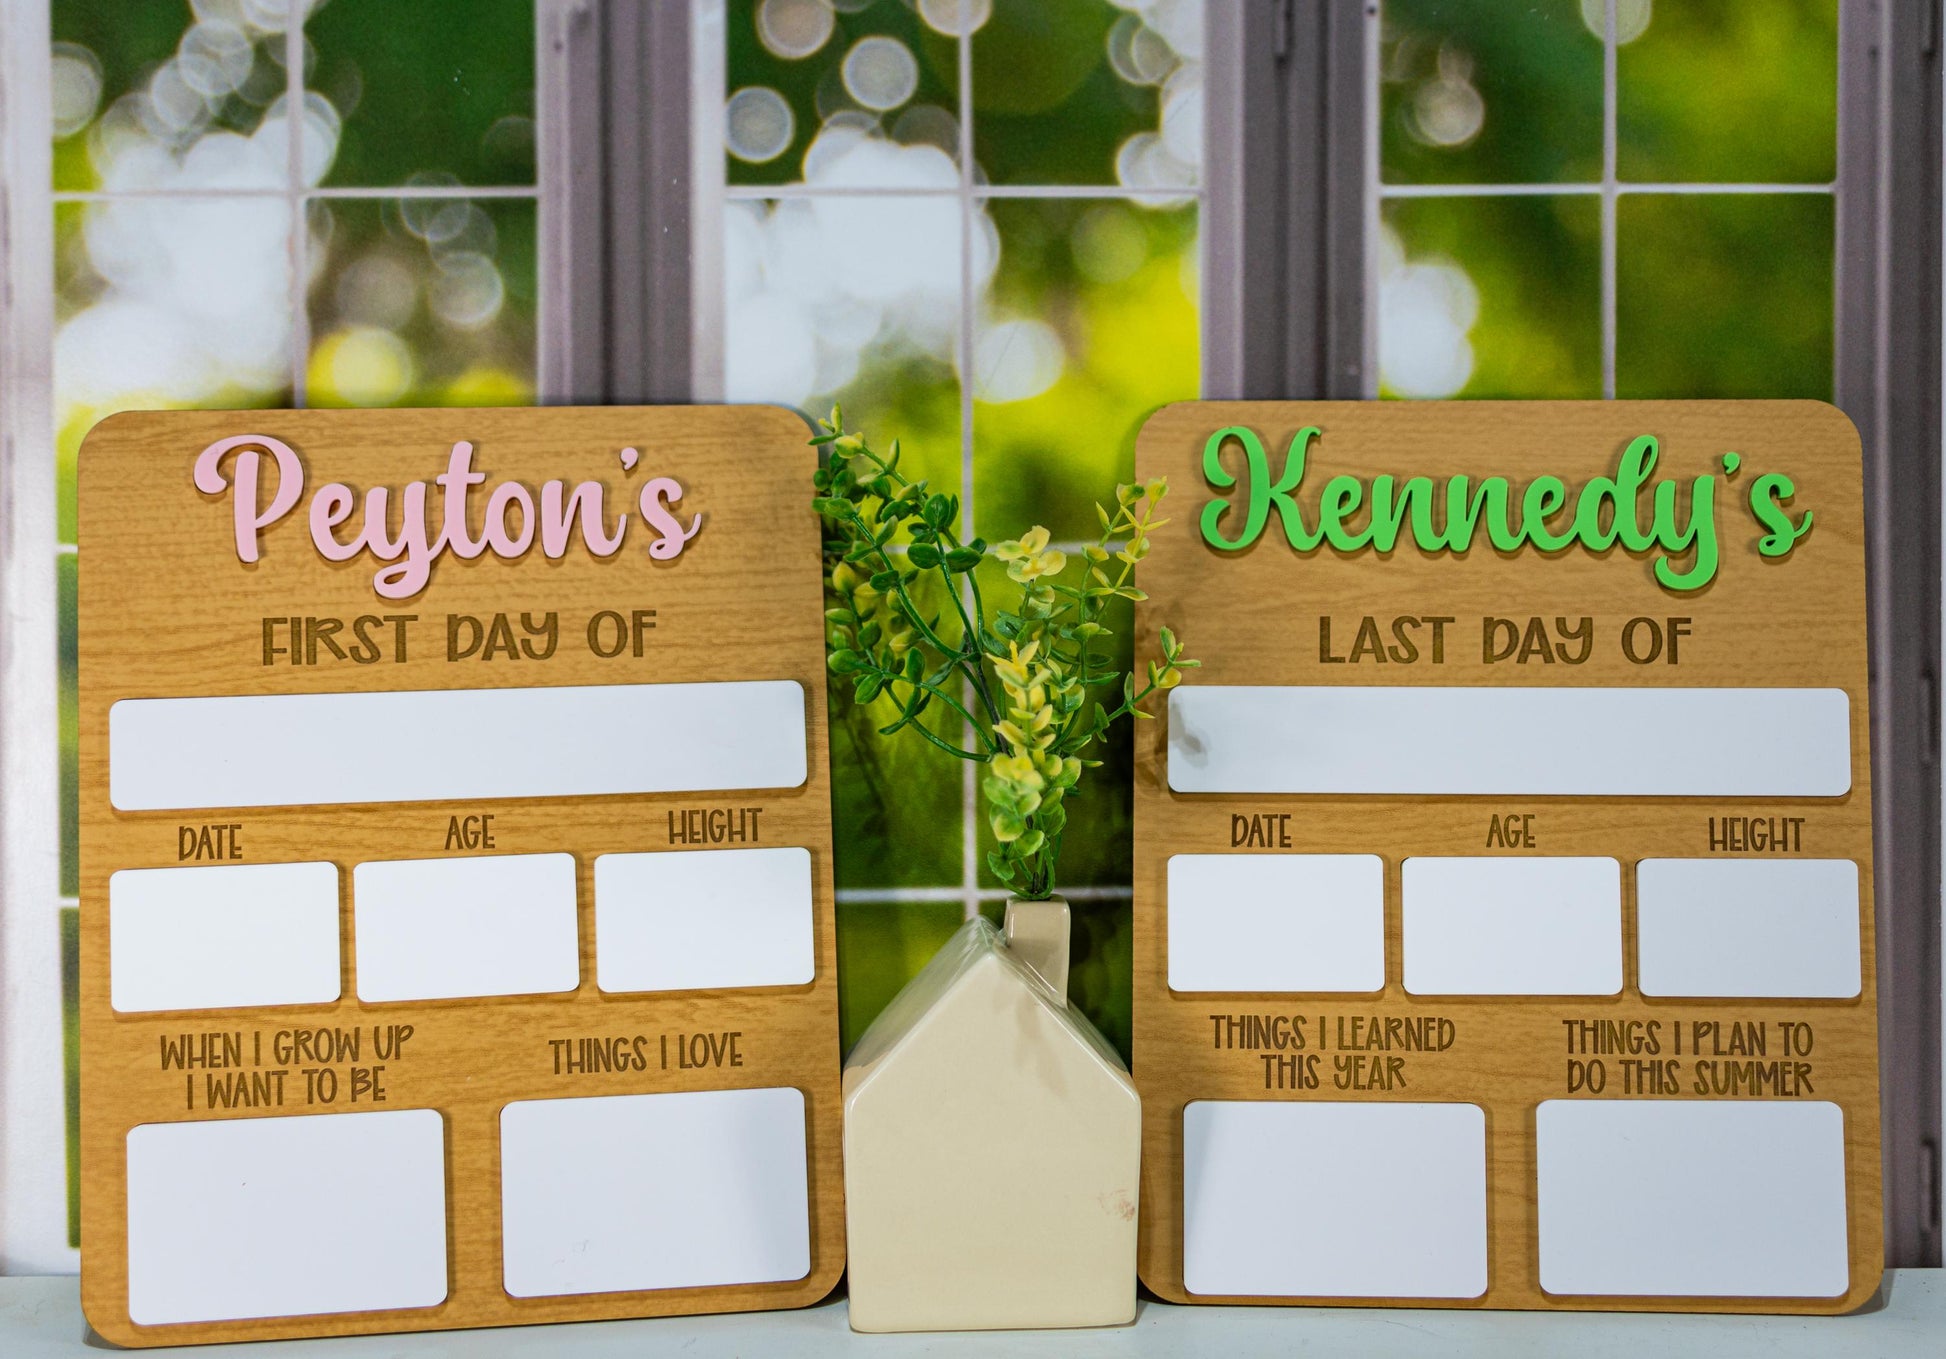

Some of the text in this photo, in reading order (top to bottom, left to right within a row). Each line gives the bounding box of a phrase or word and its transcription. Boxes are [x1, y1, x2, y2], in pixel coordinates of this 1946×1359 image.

[193, 434, 702, 600] Peyton's
[1201, 425, 1813, 590] Kennedy's
[262, 609, 658, 666] FIRST DAY OF
[1319, 616, 1692, 665] LAST DAY OF
[178, 824, 243, 861] DATE
[444, 815, 496, 851] AGE
[668, 808, 764, 845] HEIGHT
[1231, 813, 1292, 848] DATE
[1486, 814, 1536, 849] AGE
[1708, 817, 1805, 852] HEIGHT
[160, 1025, 414, 1069] WHEN I GROW UP
[1209, 1014, 1456, 1052] THINGS I LEARNED
[1562, 1019, 1813, 1057] THINGS I PLAN TO
[548, 1031, 744, 1075] THINGS I LOVE
[186, 1066, 387, 1109] I WANT TO BE
[1260, 1054, 1406, 1091] THIS YEAR
[1567, 1059, 1816, 1097] DO THIS SUMMER
